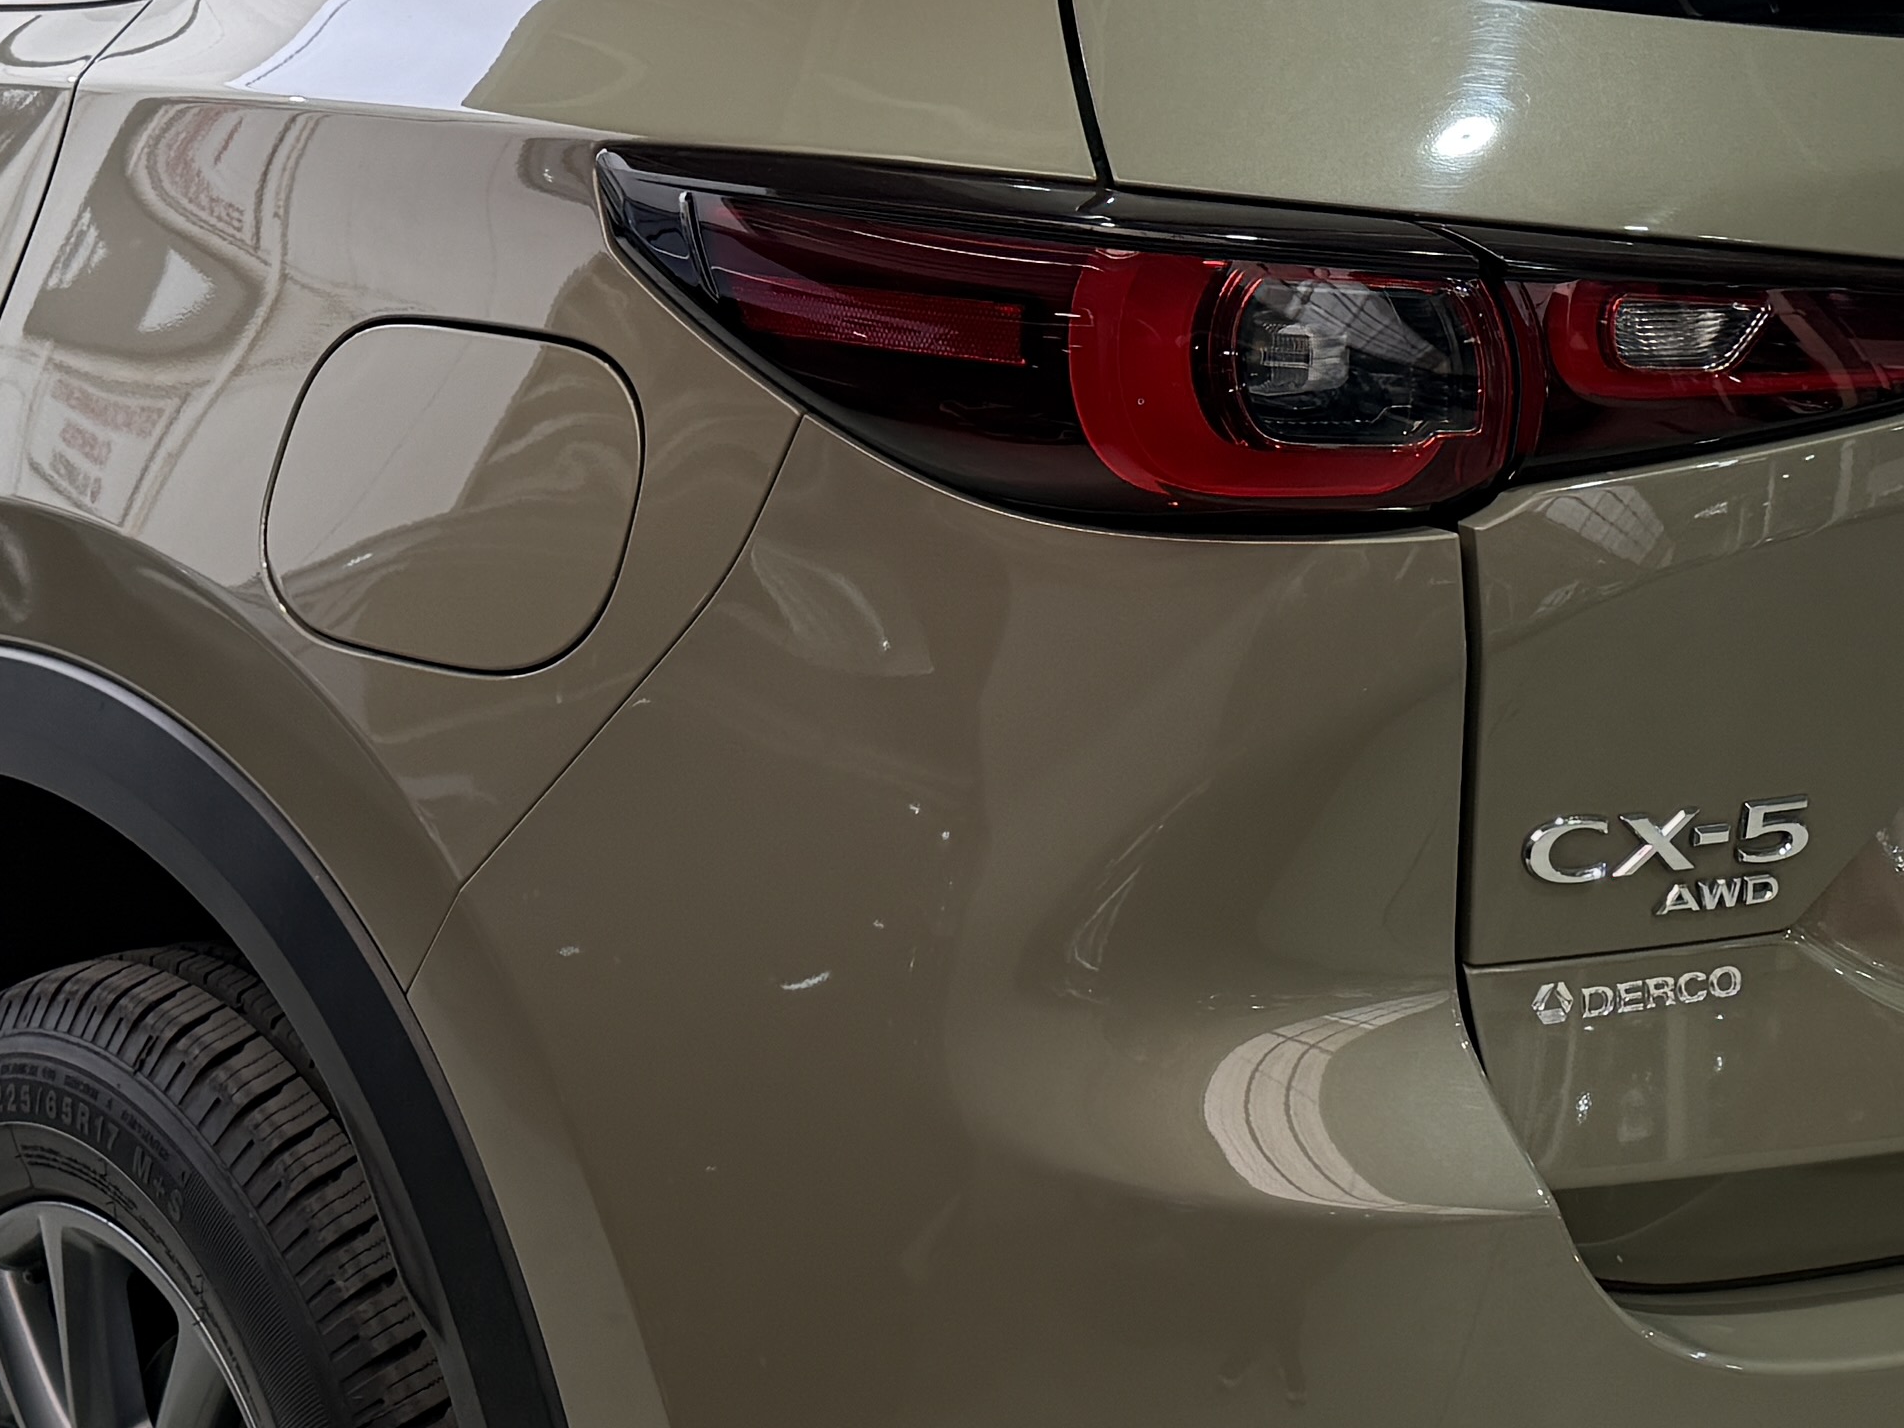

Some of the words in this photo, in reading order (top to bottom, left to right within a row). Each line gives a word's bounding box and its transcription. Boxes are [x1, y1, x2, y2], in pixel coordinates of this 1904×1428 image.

[1522, 793, 1809, 885] CX-5
[1652, 873, 1780, 916] AWD
[1581, 965, 1742, 1019] DERCO
